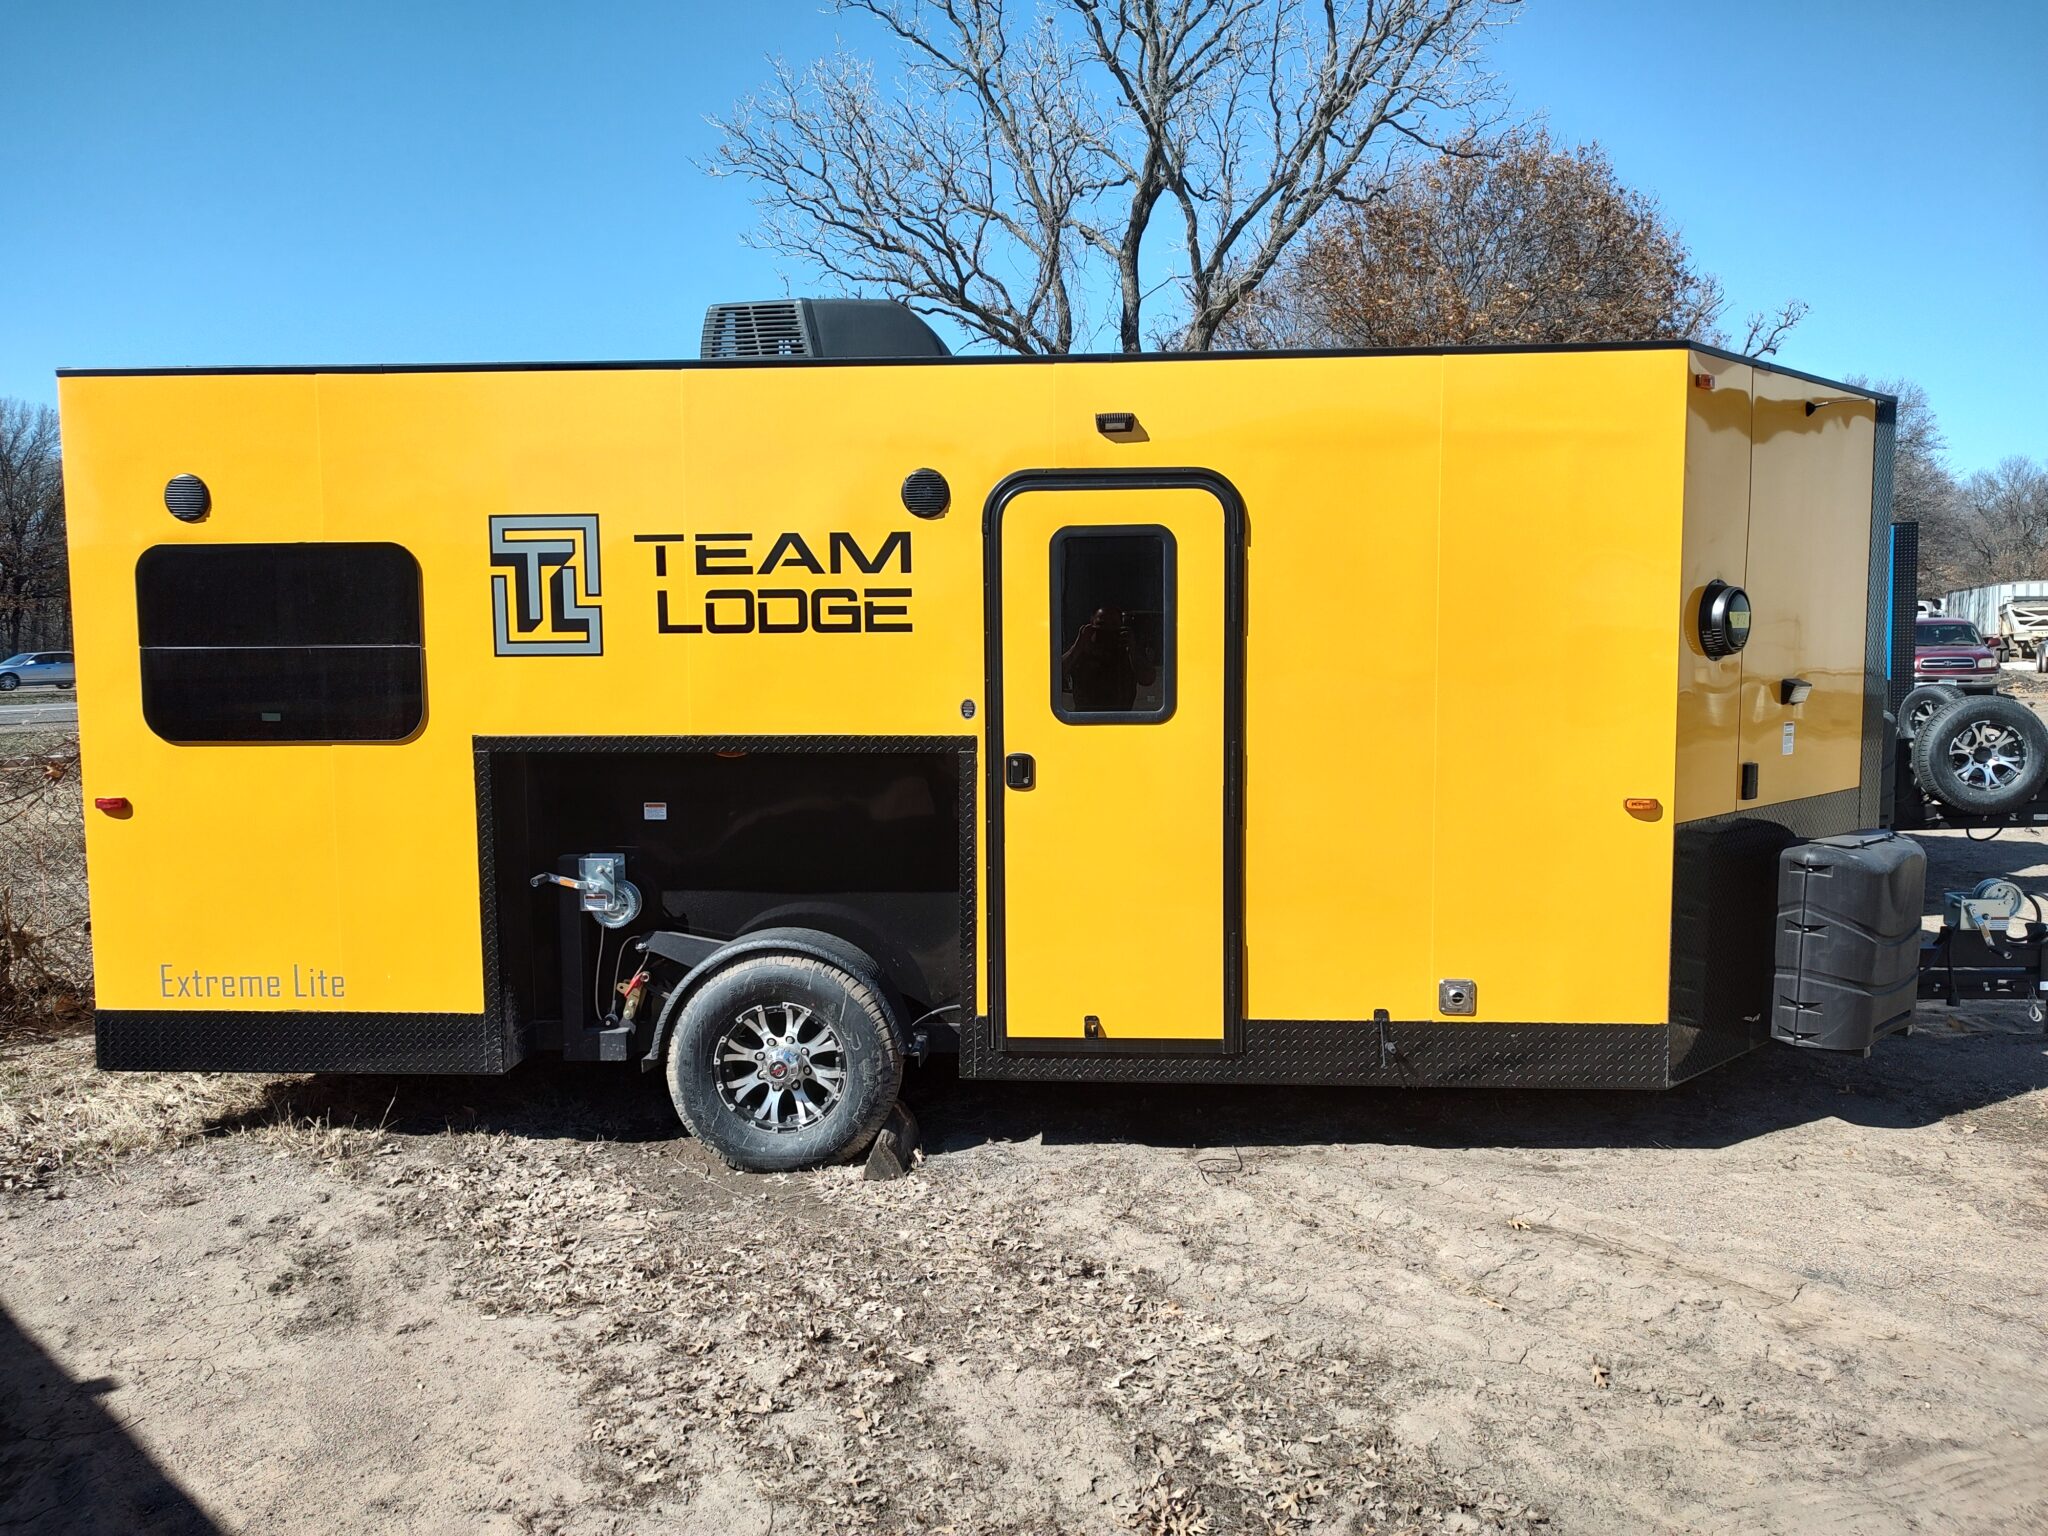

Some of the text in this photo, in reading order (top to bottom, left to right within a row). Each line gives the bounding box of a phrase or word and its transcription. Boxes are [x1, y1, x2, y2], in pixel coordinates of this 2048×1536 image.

[634, 531, 912, 576] TEAM
[657, 588, 913, 634] LODGE
[160, 964, 345, 998] Extreme Lite
